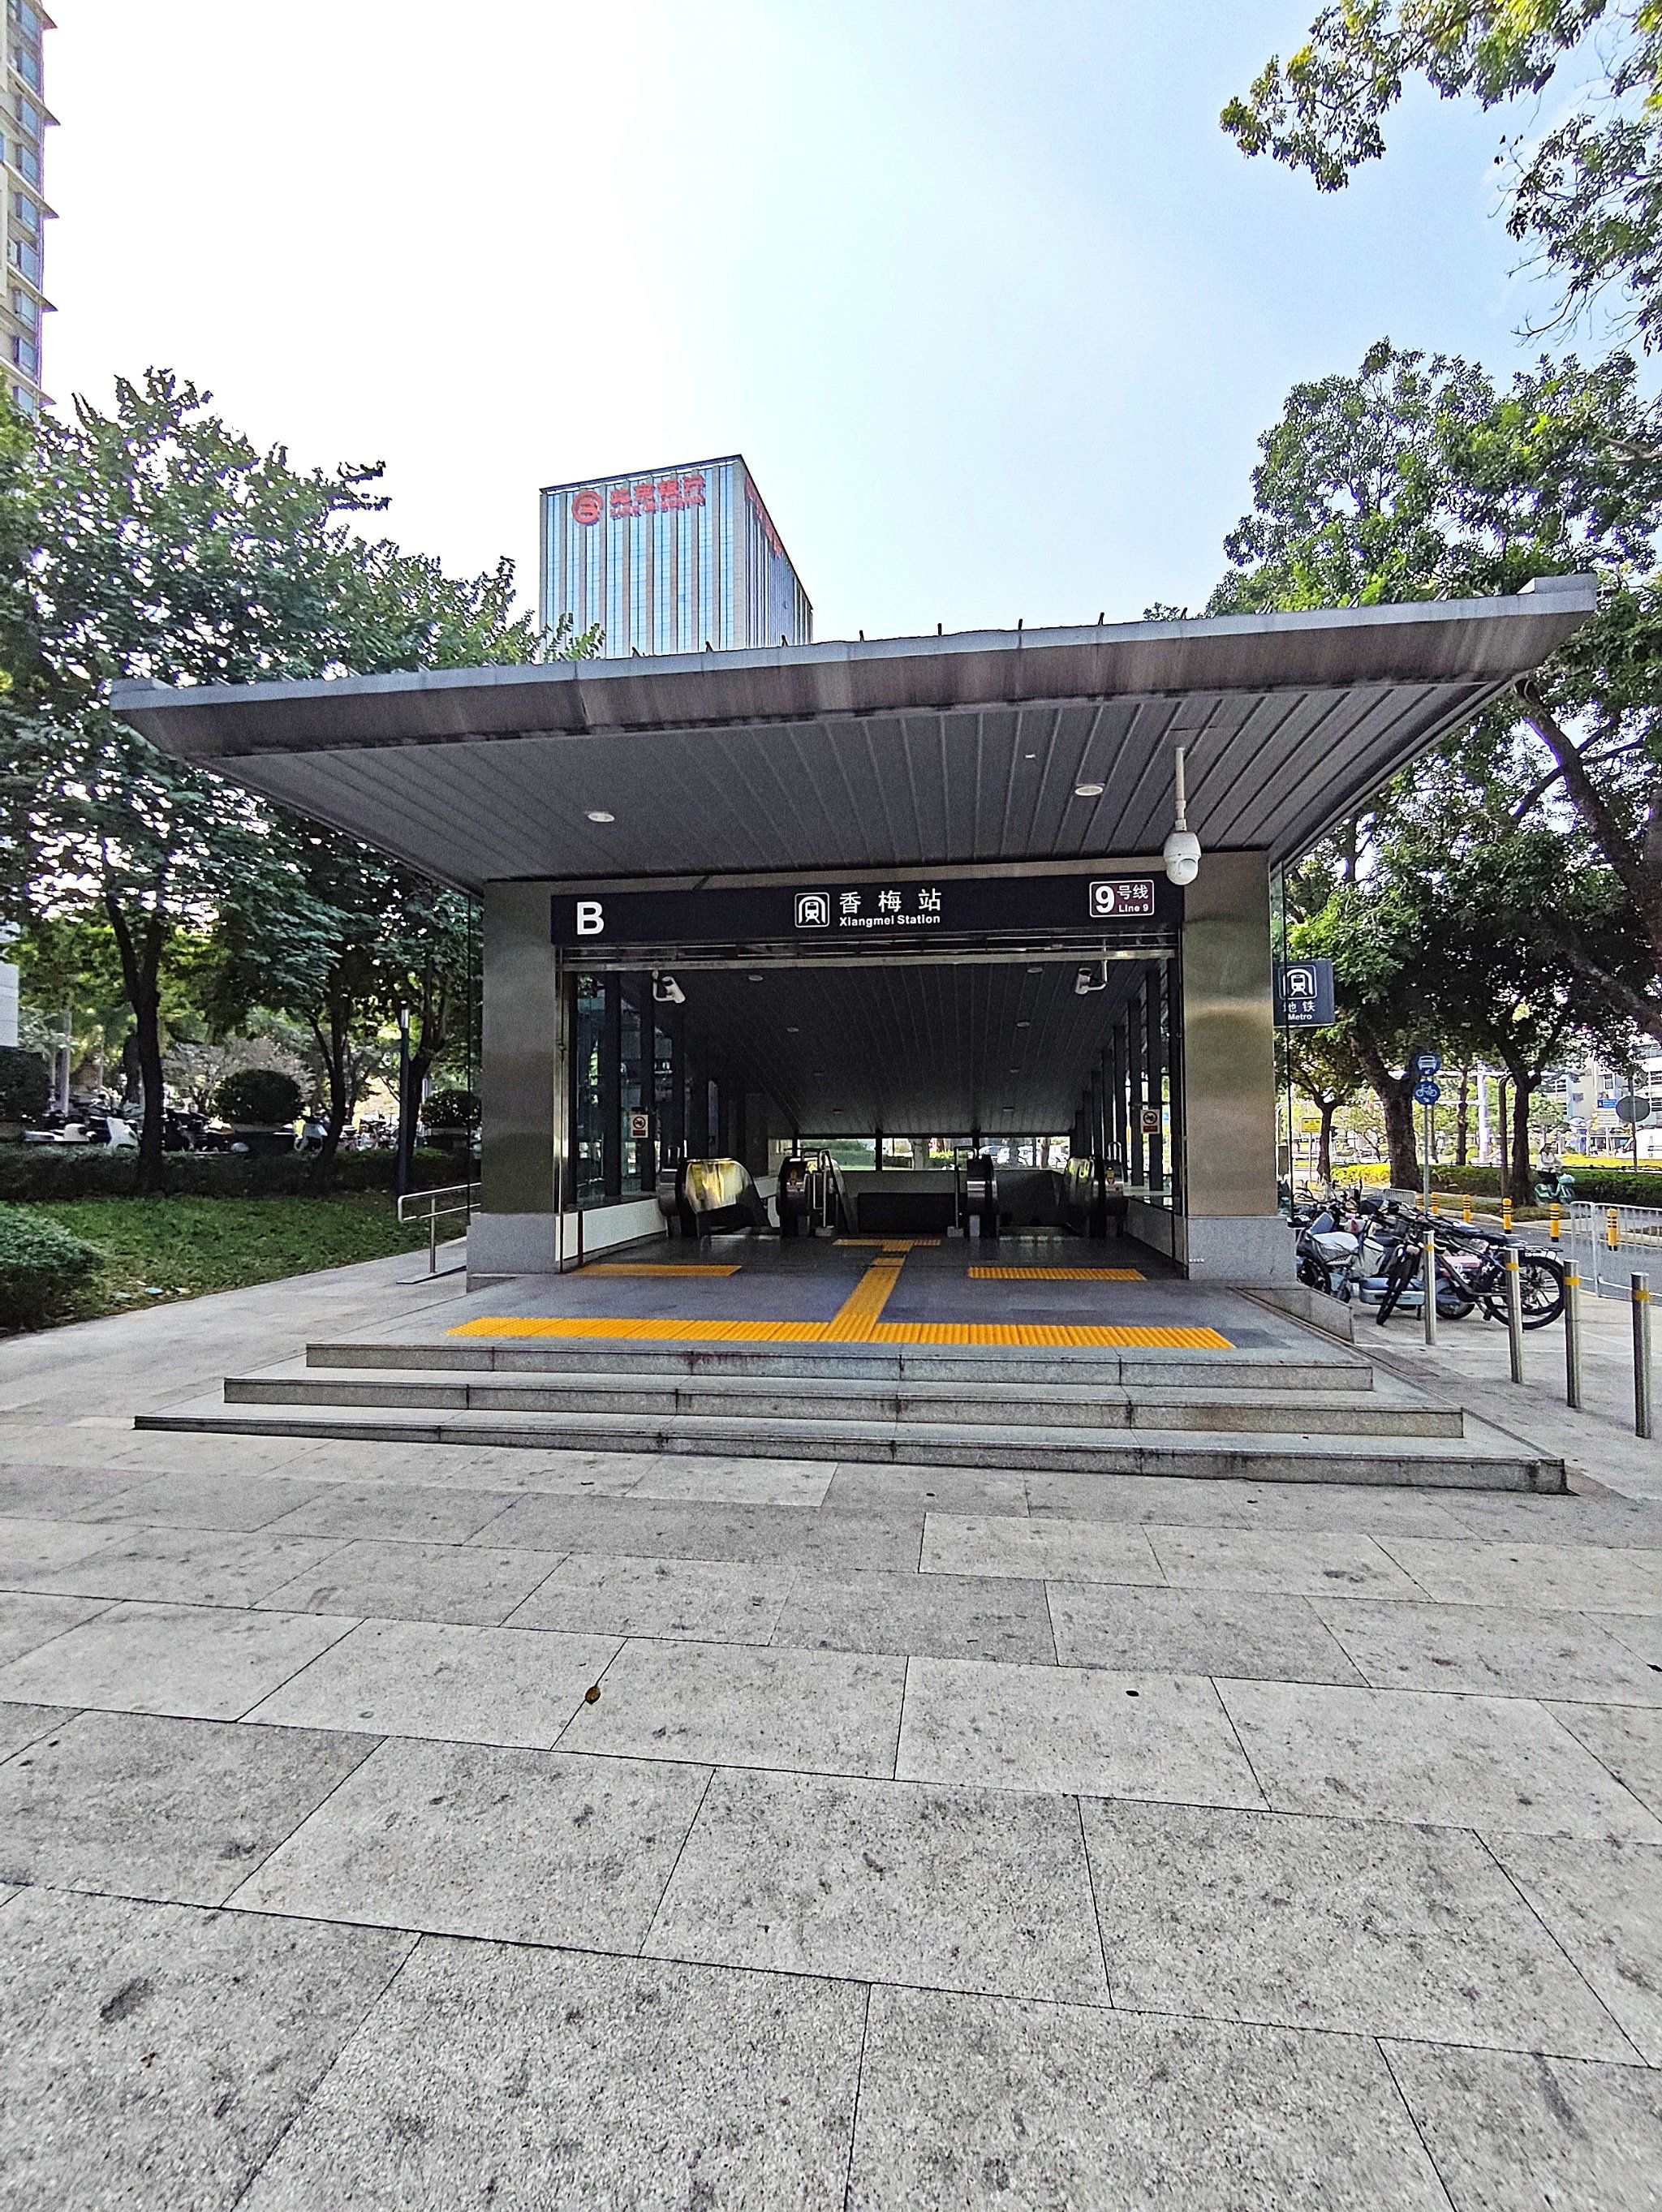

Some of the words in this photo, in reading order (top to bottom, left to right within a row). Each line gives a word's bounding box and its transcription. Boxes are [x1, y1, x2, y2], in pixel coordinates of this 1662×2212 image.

[839, 888, 942, 914] 香梅站
[1118, 905, 1140, 913] Line
[1142, 904, 1149, 912] 9
[577, 902, 605, 935] B
[839, 914, 894, 927] Xiangmei
[897, 914, 941, 925] Station
